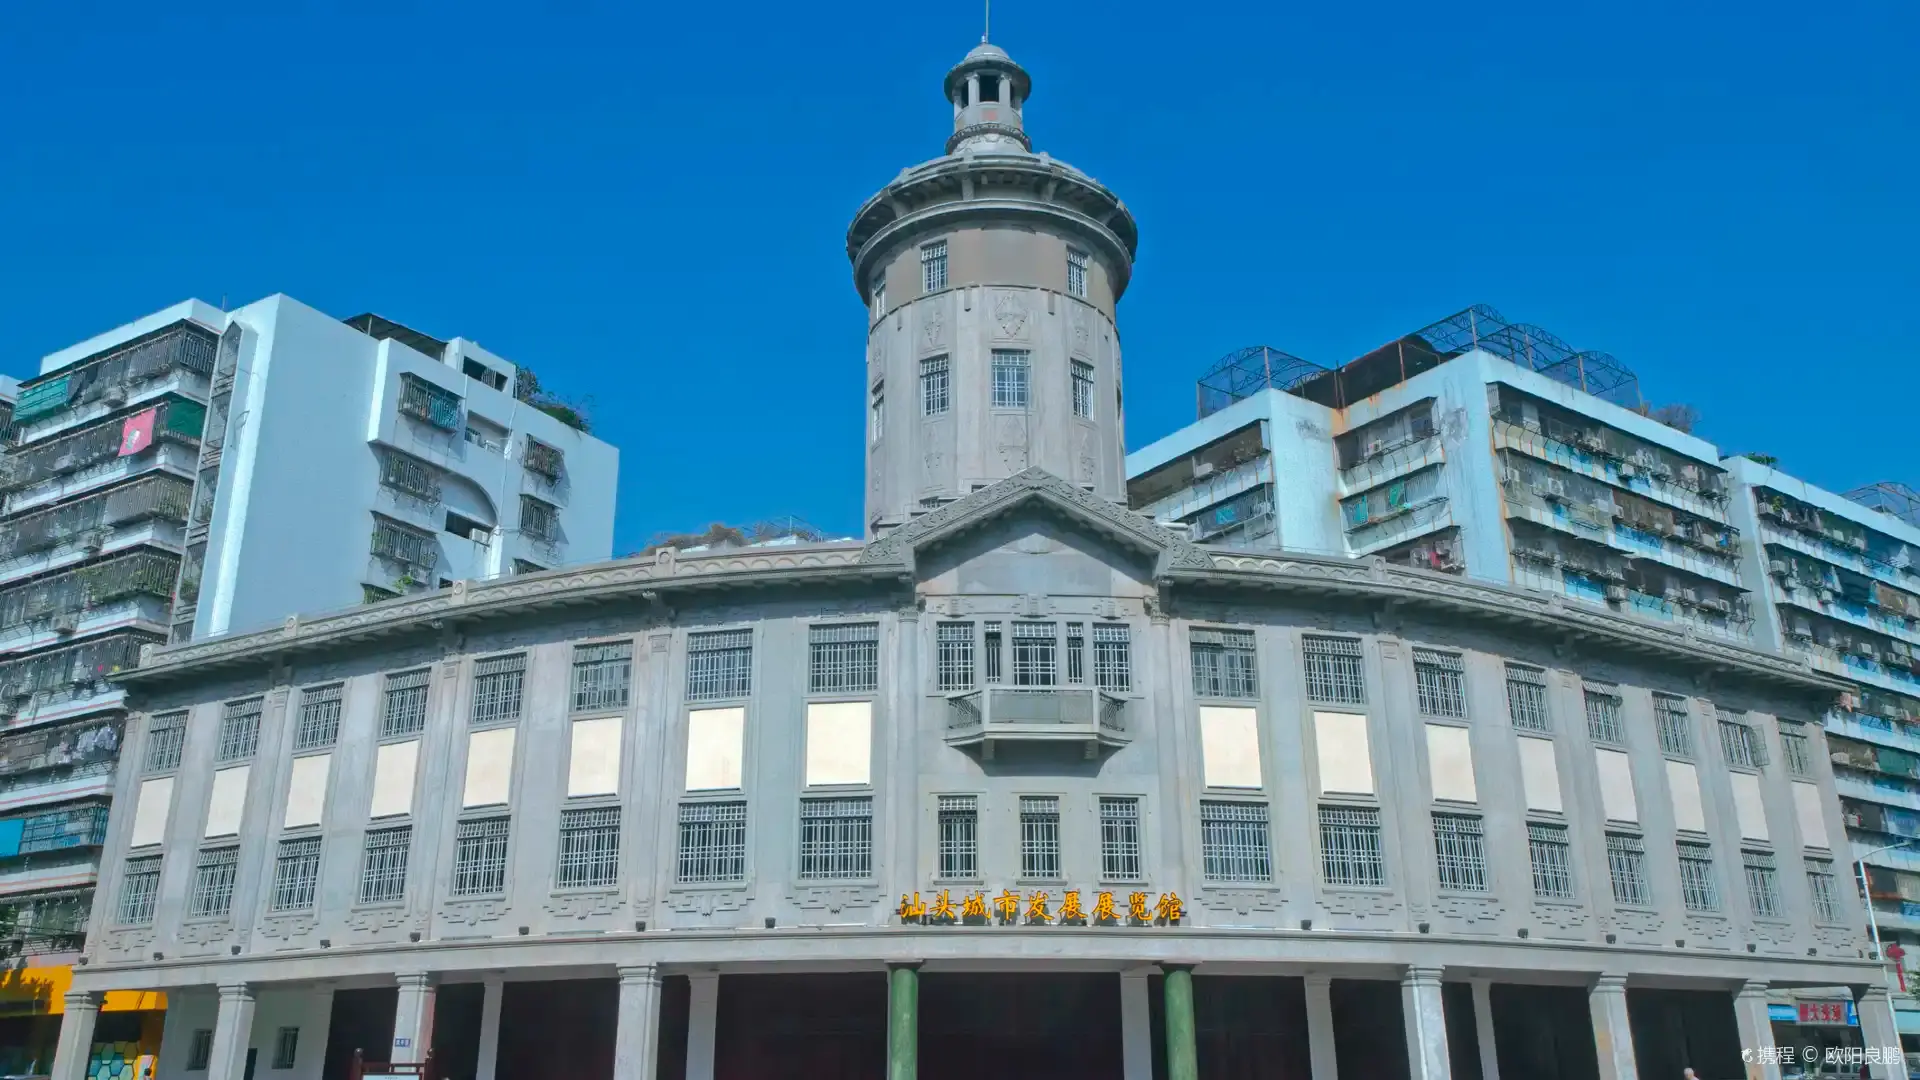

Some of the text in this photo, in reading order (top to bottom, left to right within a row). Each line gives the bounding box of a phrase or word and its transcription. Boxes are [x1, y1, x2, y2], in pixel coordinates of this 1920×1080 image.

[900, 888, 1184, 920] 汕头城市发展展览馆
